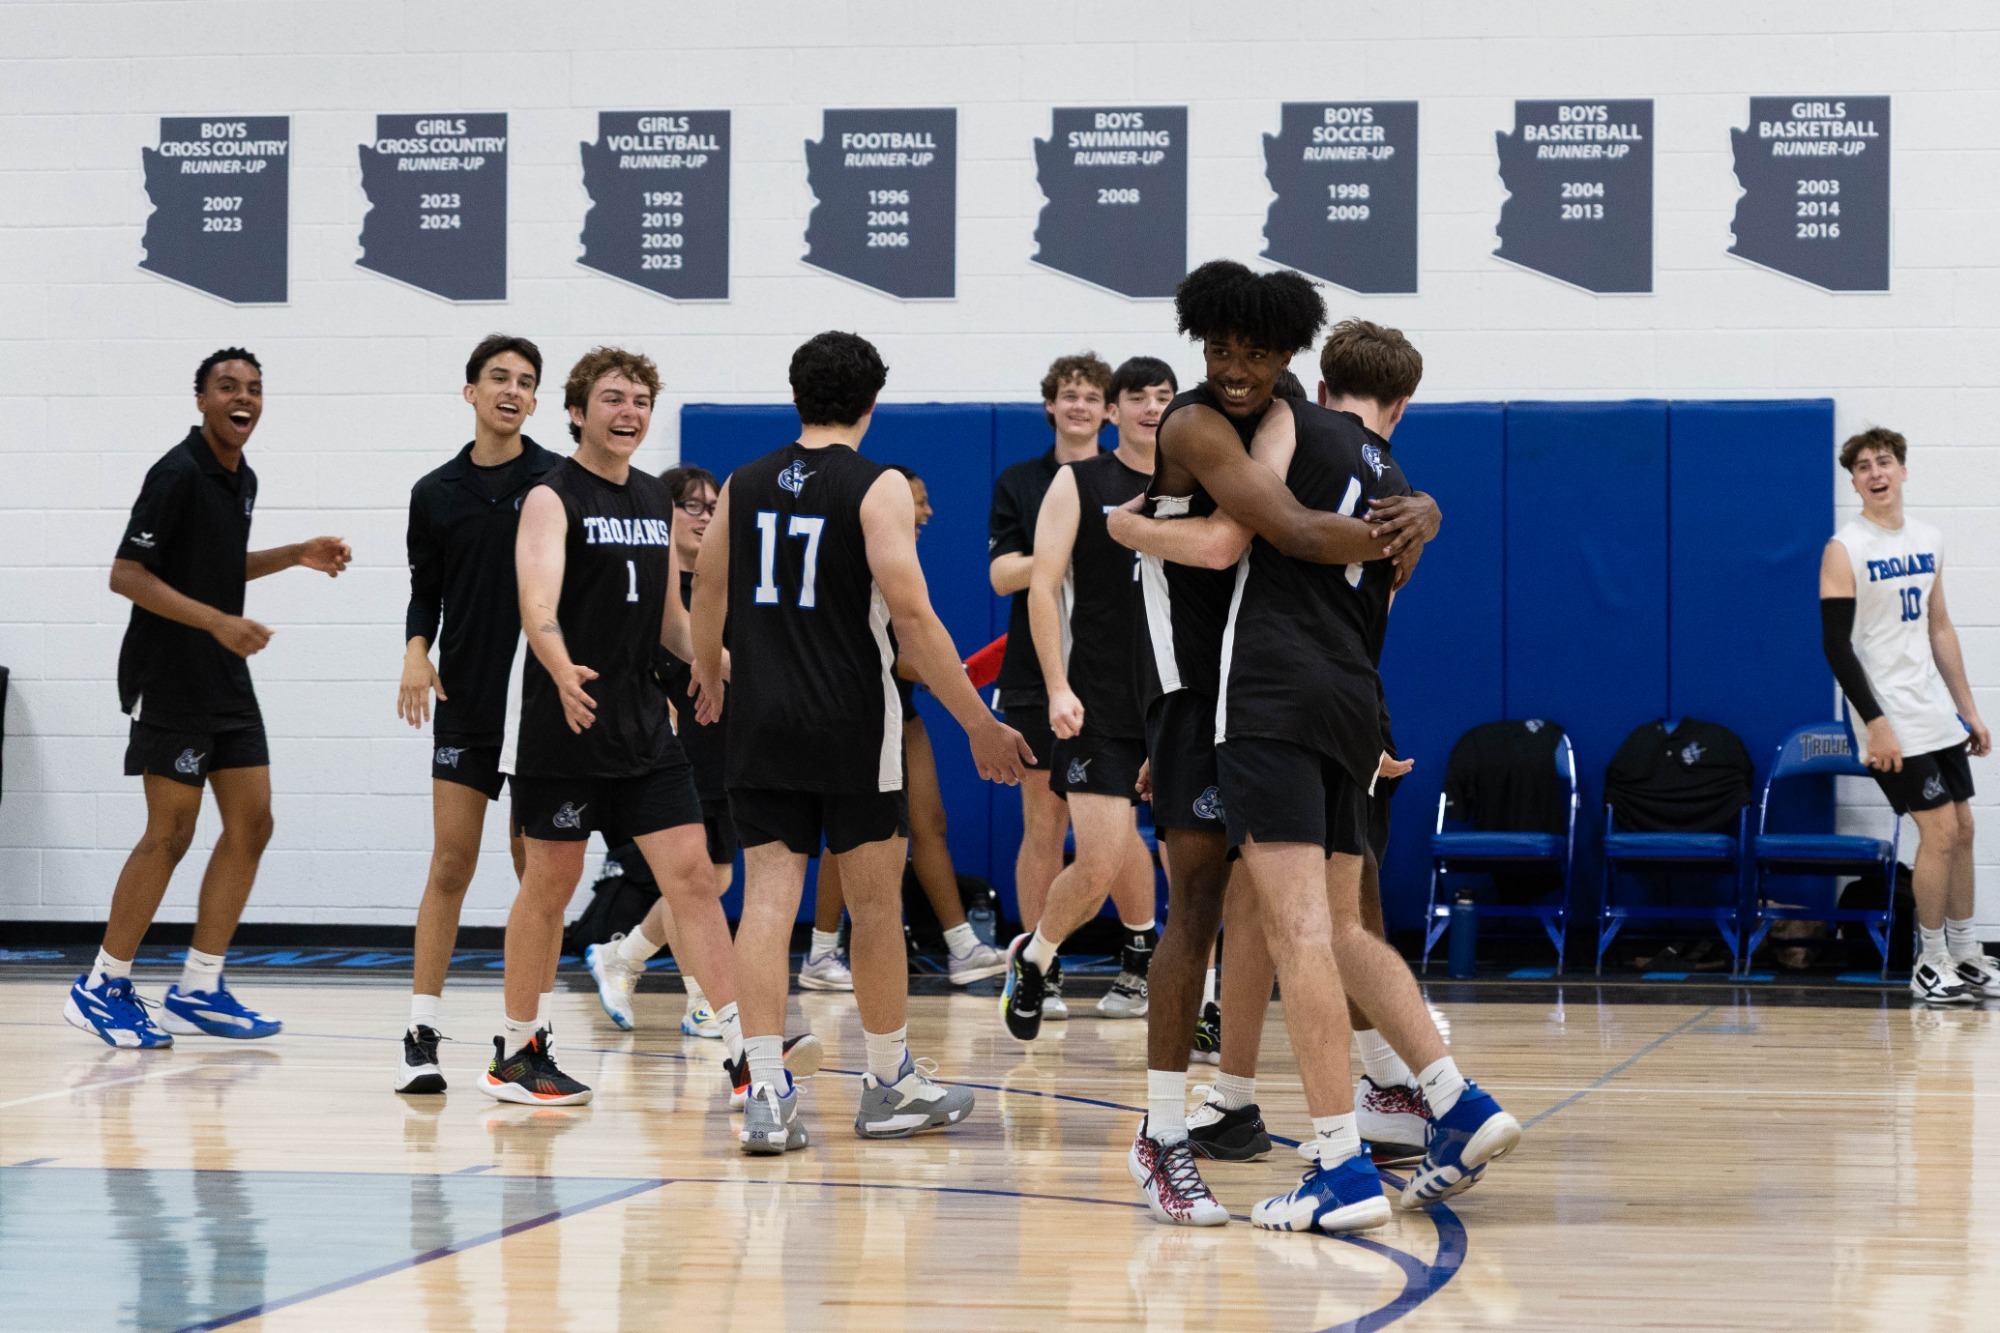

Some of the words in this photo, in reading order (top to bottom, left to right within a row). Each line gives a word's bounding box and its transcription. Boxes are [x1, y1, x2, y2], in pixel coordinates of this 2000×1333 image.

[1323, 106, 1374, 125] BOYS
[1558, 105, 1609, 124] BOYS
[1791, 101, 1847, 120] GIRLS
[415, 118, 467, 136] GIRLS
[637, 116, 690, 134] GIRLS
[1094, 111, 1144, 130] BOYS
[200, 122, 248, 139] BOYS
[1312, 125, 1386, 144] SOCCER
[1523, 123, 1643, 142] BASKETBALL
[1758, 120, 1880, 139] BASKETBALL
[159, 138, 211, 157] CROSS
[212, 138, 288, 157] COUNTRY
[376, 136, 427, 155] CROSS
[428, 136, 506, 154] COUNTRY
[606, 134, 720, 152] VOLLEYBALL
[841, 132, 937, 150] FOOTBALL
[1068, 130, 1171, 149] SWIMMING
[1302, 145, 1395, 162] RUNNER-UP
[1536, 143, 1630, 160] RUNNER-UP
[1771, 140, 1866, 157] RUNNER-UP
[397, 156, 486, 172] RUNNER-UP
[619, 153, 708, 170] RUNNER-UP
[844, 151, 934, 168] RUNNER-UP
[1073, 150, 1165, 166] RUNNER-UP
[180, 159, 267, 175] RUNNER-UP
[1327, 183, 1370, 200] 1998
[1560, 182, 1605, 199] 2004
[1796, 179, 1840, 196] 2003
[202, 196, 243, 212] 2007
[420, 193, 461, 209] 2023
[642, 191, 684, 207] 1992
[868, 189, 910, 205] 1996
[1097, 188, 1141, 205] 2008
[1326, 204, 1371, 221] 2009
[1560, 203, 1604, 220] 2013
[1796, 200, 1841, 217] 2014
[202, 216, 243, 232] 2023
[419, 214, 462, 230] 2024
[641, 212, 684, 228] 2019
[867, 210, 910, 227] 2004
[1796, 222, 1841, 239] 2016
[641, 233, 684, 249] 2020
[866, 231, 910, 248] 2006
[641, 254, 683, 270] 2023
[583, 515, 669, 547] TROJANS
[753, 510, 826, 610] 17
[1866, 552, 1936, 582] TROJANS
[625, 559, 640, 603] 1
[1899, 586, 1922, 622] 10
[751, 1130, 765, 1140] 23
